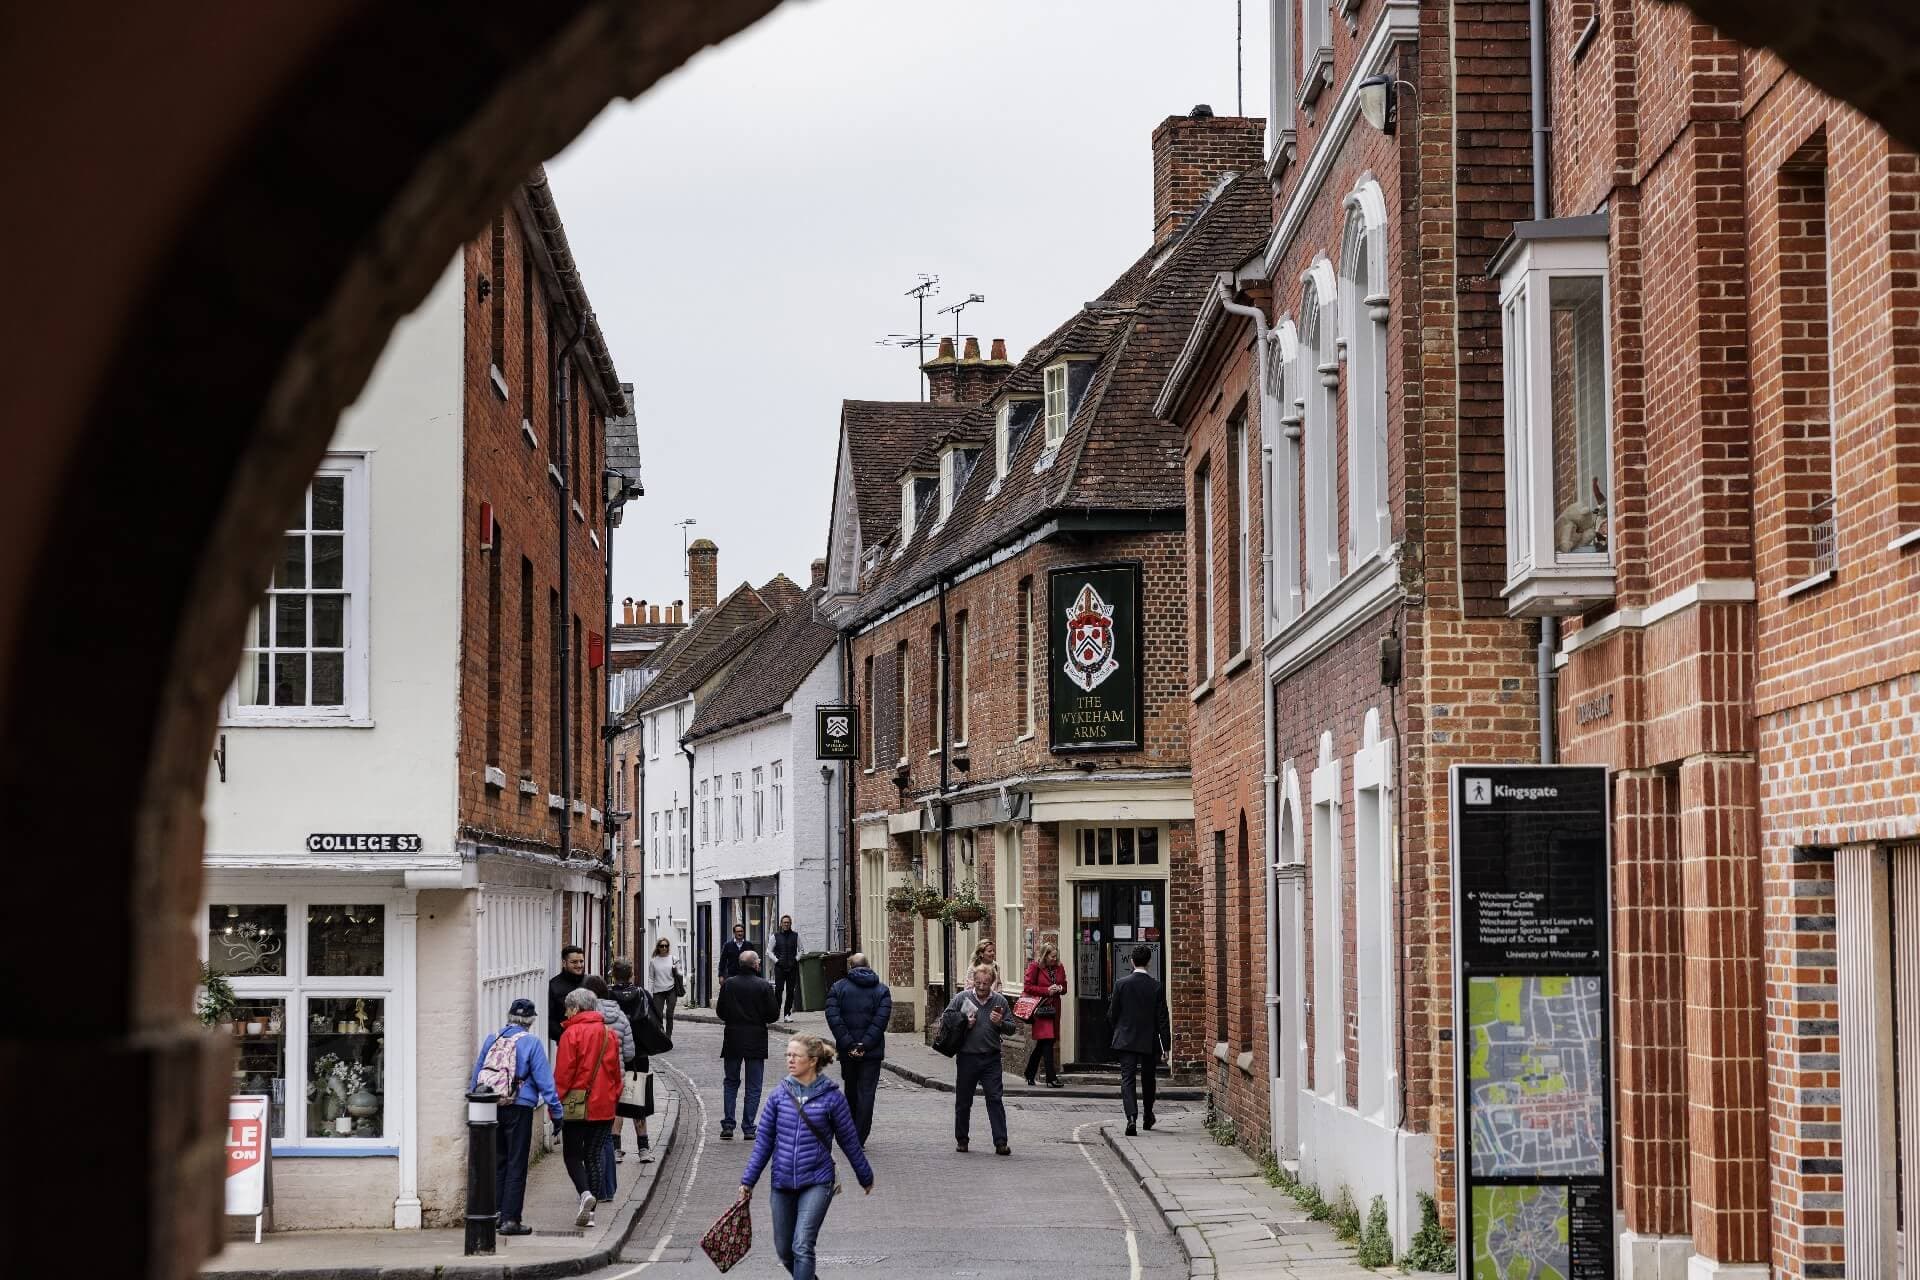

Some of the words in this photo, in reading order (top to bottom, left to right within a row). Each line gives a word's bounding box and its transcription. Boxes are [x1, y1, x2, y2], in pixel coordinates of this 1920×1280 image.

[1076, 696, 1102, 709] THE
[1061, 709, 1125, 725] WYKEHAM
[1073, 725, 1107, 739] ARMS
[1494, 784, 1558, 800] Kingsgate
[309, 836, 391, 850] COLLEGE
[397, 836, 418, 850] ST
[1479, 891, 1518, 900] Winchester
[1519, 891, 1545, 901] College
[1512, 900, 1534, 908] Castle
[1479, 909, 1501, 917] Water
[1502, 909, 1534, 917] Meadows
[1479, 918, 1518, 926] Winchester
[1519, 918, 1538, 927] Sport
[1540, 918, 1553, 926] and
[1553, 918, 1577, 926] Leisure
[1578, 917, 1594, 926] Park
[1479, 927, 1518, 935] Winchester
[1519, 927, 1541, 936] Sports
[1543, 927, 1569, 935] Stadium
[1479, 935, 1507, 944] Hospital
[1508, 935, 1516, 943] of
[1527, 935, 1548, 943] Cross
[1505, 950, 1539, 960] University
[1540, 950, 1549, 959] of
[1549, 950, 1588, 959] Winchester
[231, 1150, 257, 1160] ON
